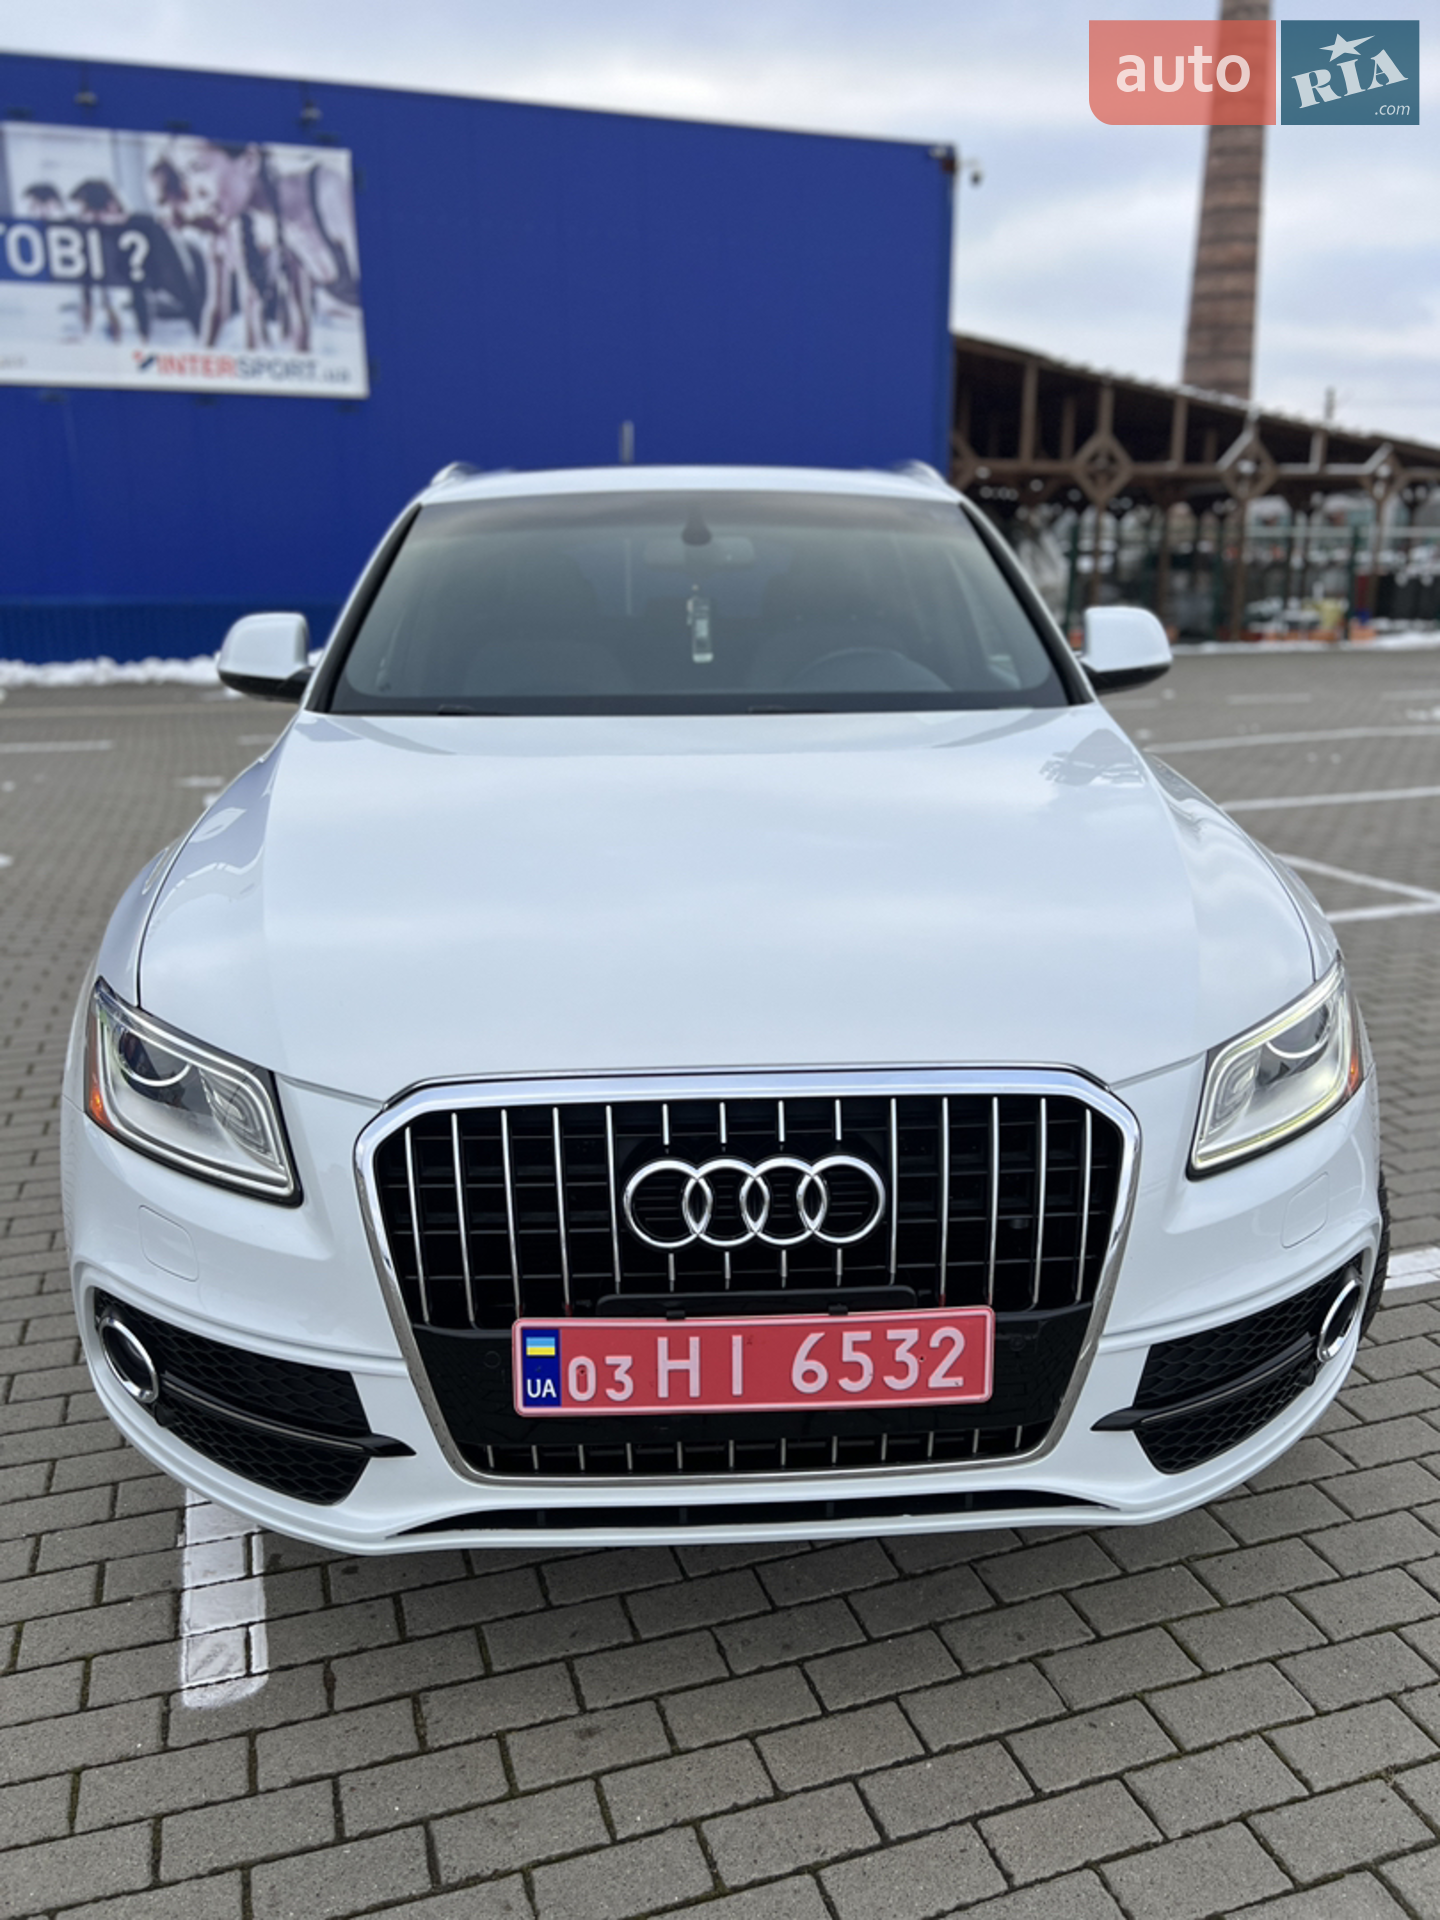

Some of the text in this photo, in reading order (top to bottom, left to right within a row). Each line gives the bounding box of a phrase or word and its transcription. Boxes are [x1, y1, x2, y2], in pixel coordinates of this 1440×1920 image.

[0, 222, 105, 280] ОВІ
[526, 1378, 557, 1398] UA
[567, 1355, 634, 1402] 03
[790, 1326, 966, 1394] 6532
